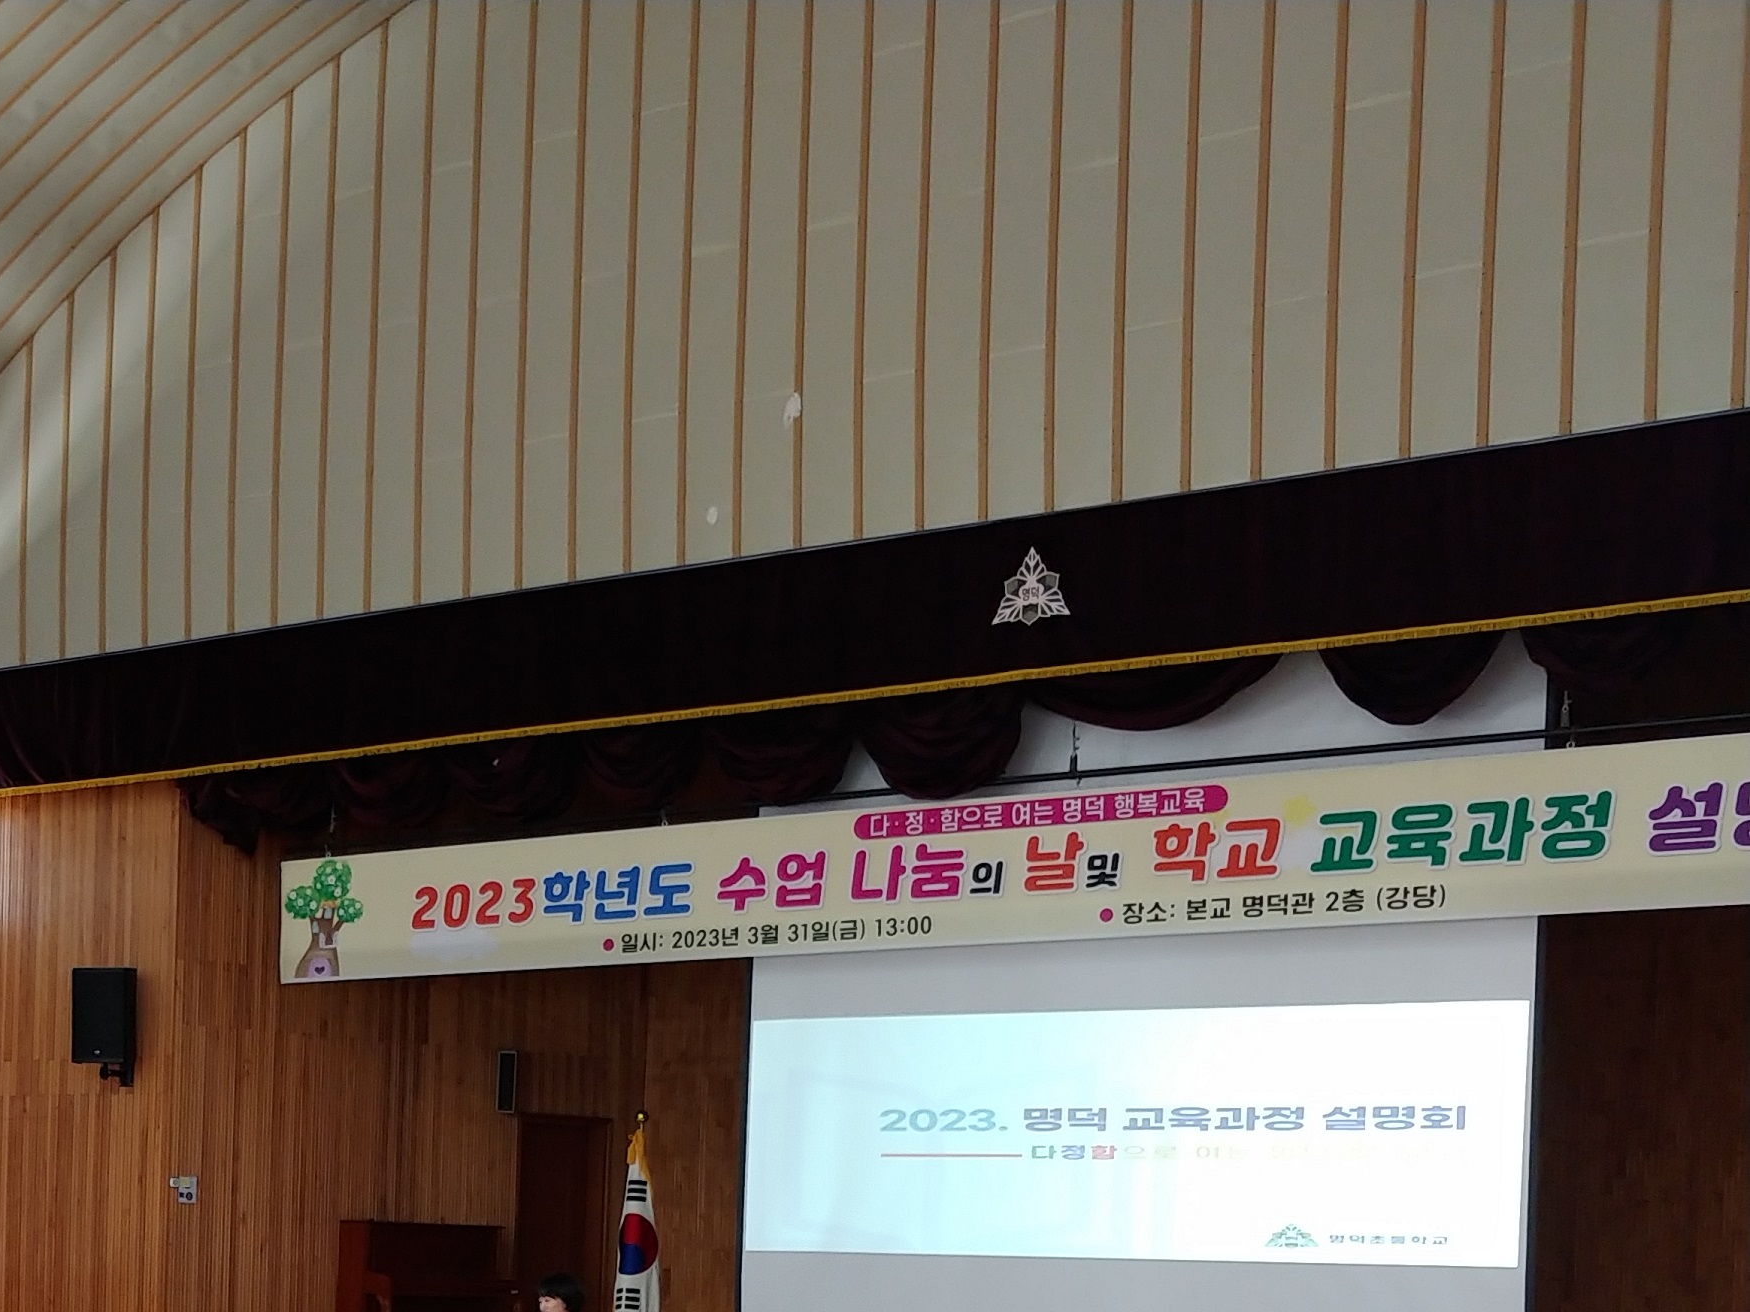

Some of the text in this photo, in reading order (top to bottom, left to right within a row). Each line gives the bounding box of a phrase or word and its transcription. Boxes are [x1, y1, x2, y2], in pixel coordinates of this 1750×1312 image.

[1011, 801, 1054, 826] 여는
[1062, 796, 1104, 824] 명덕
[1114, 788, 1206, 819] 행복교육
[411, 863, 693, 930] 2023학년도
[716, 850, 826, 912] 수업
[850, 843, 1004, 902] 나눔의
[1153, 818, 1281, 882] 학교
[1310, 790, 1613, 873] 교육과정
[1648, 781, 1750, 853] 설
[1122, 884, 1446, 925] 장소: 본교 명덕관 2층 (강당)
[621, 915, 933, 953] 일시: 2023년 3월 31일(금) 13:00
[879, 1104, 1467, 1132] 2023. 명덕 교육과정 설명회
